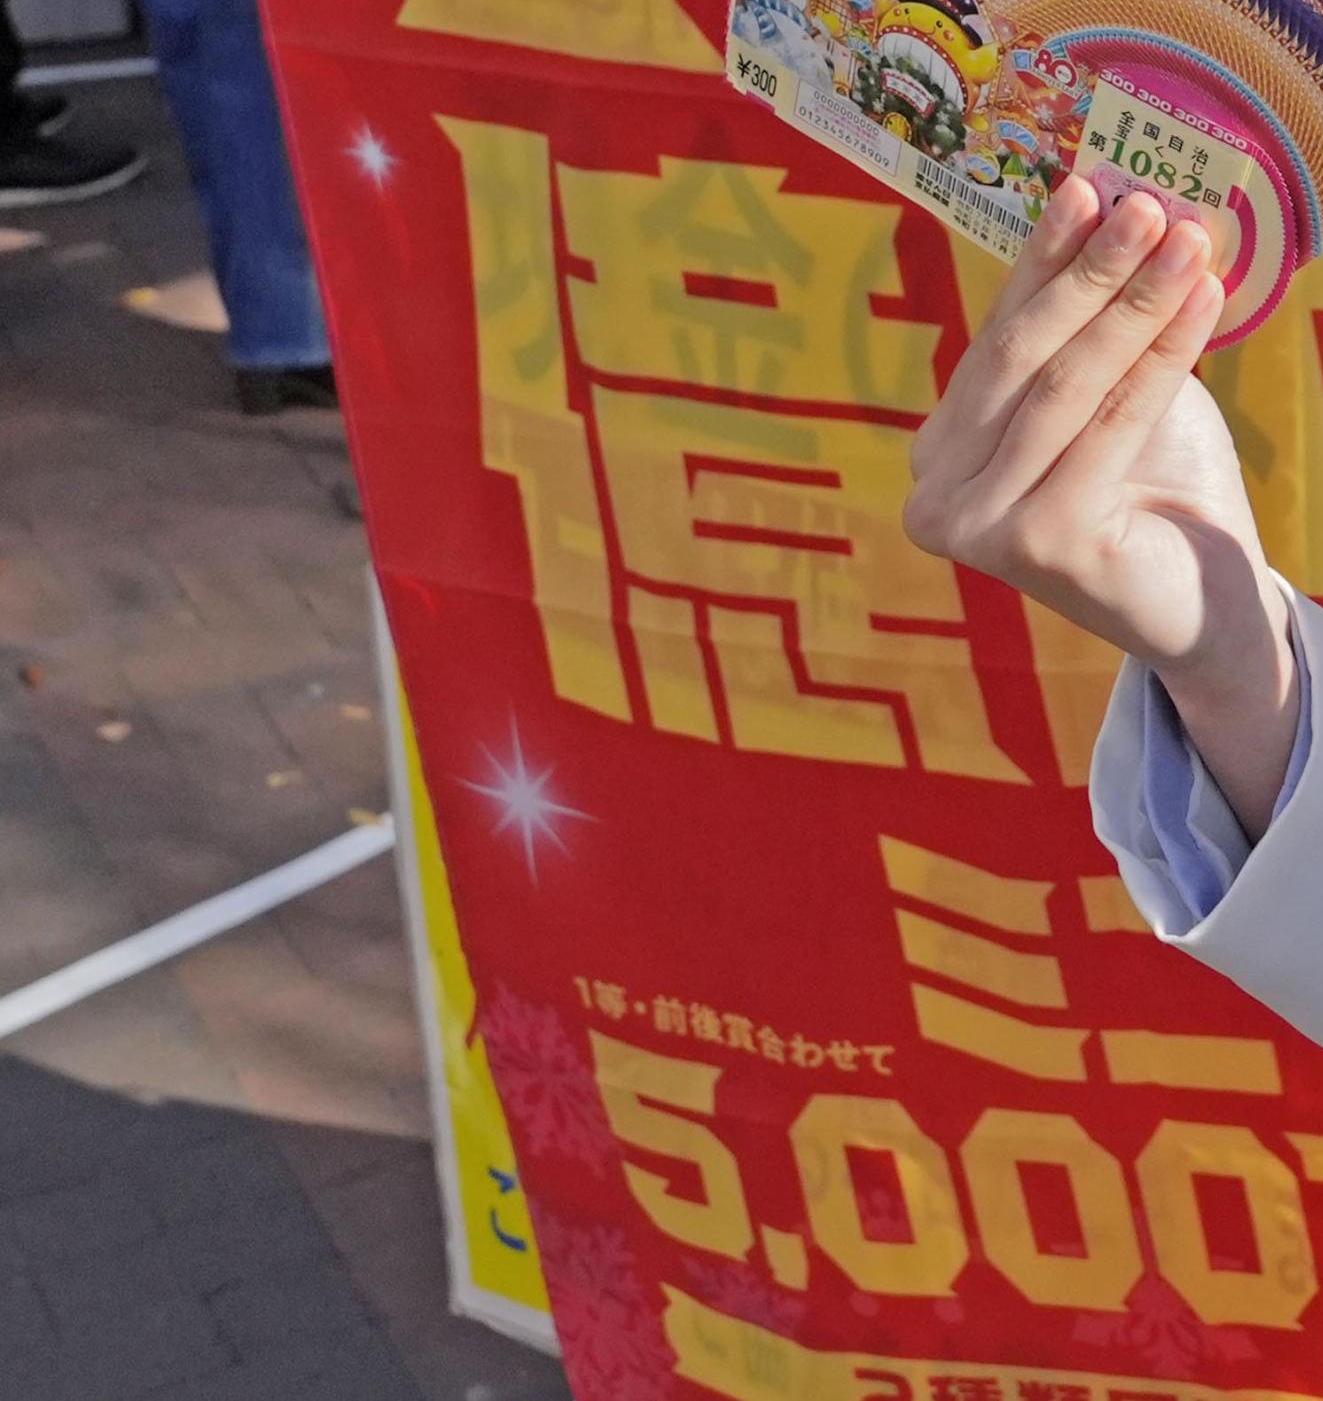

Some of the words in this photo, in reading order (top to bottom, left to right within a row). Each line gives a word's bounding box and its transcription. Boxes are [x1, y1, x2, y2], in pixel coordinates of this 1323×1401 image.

[736, 53, 778, 98] ¥300
[1100, 68, 1135, 95] 300
[1137, 89, 1173, 115] 300
[1173, 108, 1210, 134] 300
[1211, 126, 1248, 150] 300
[799, 106, 890, 168] 012345678909
[574, 976, 896, 1076] 1等・前後賞合わせて
